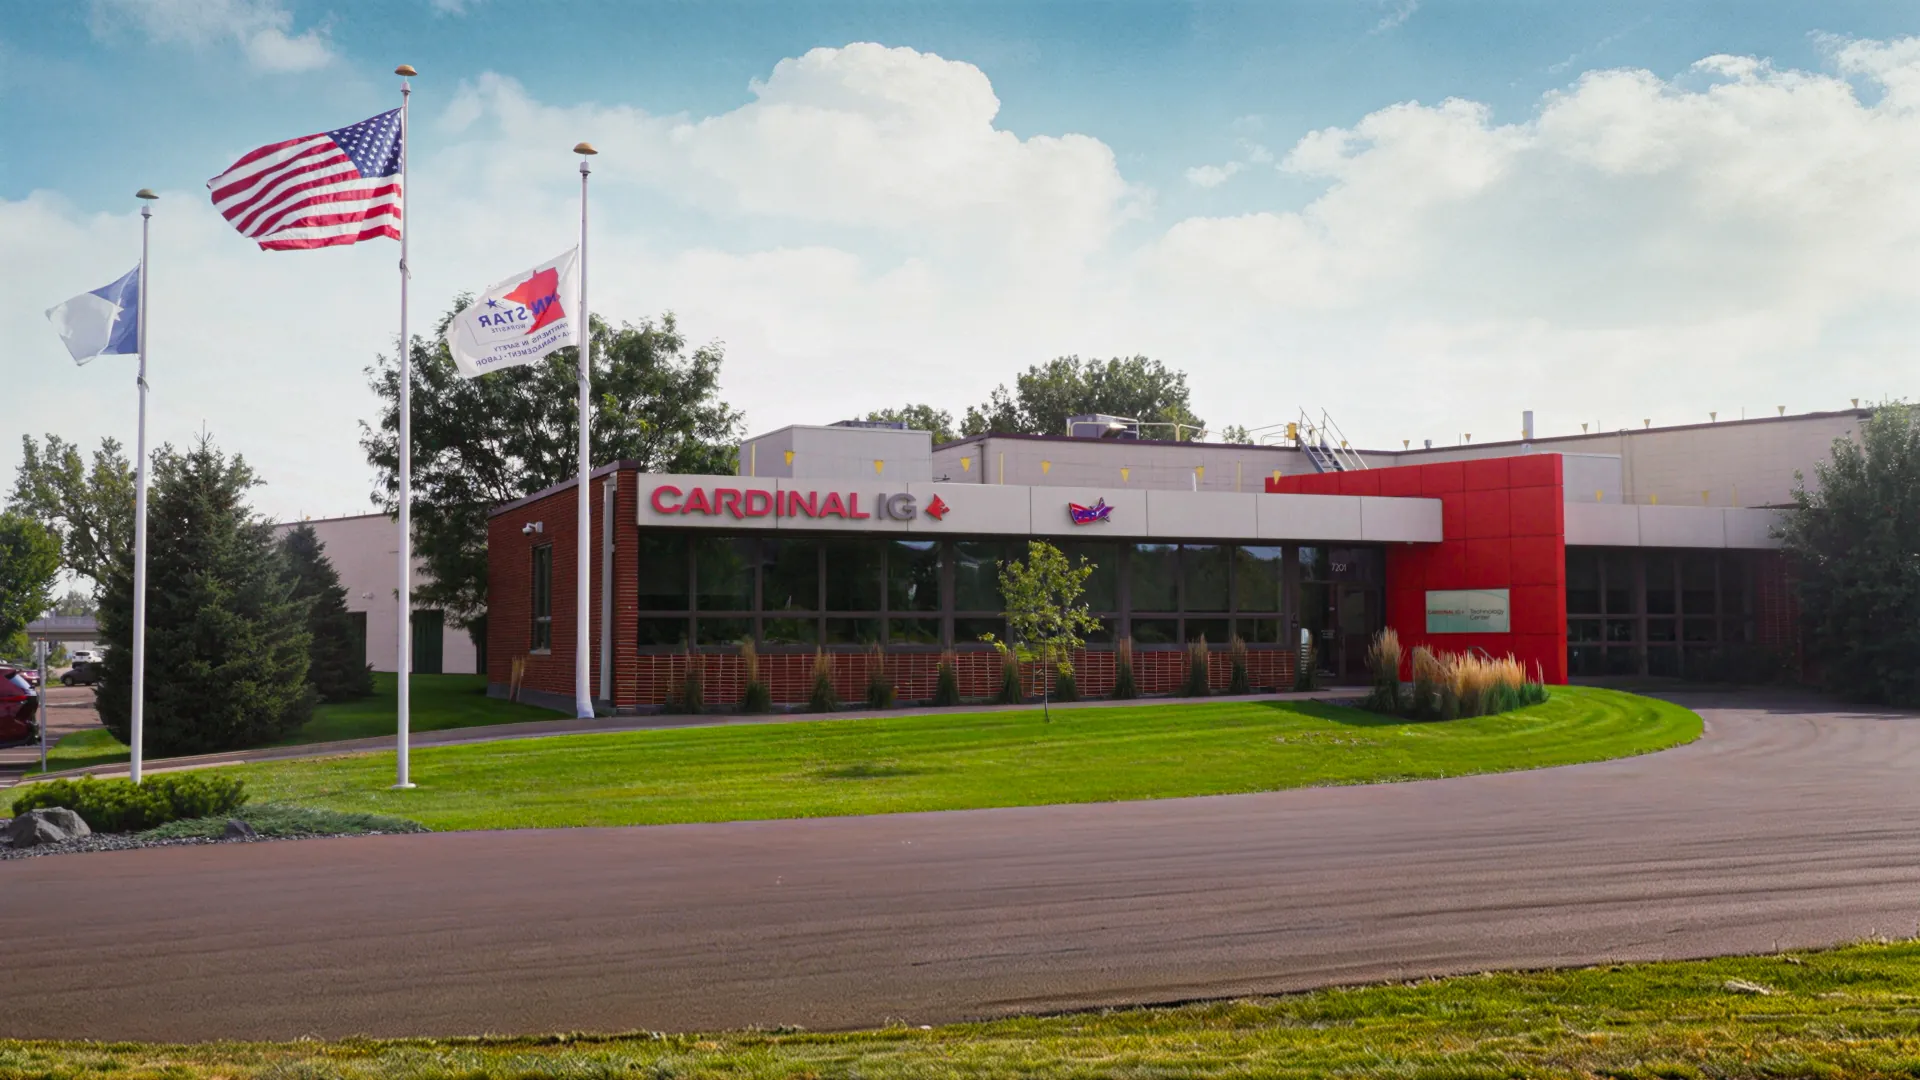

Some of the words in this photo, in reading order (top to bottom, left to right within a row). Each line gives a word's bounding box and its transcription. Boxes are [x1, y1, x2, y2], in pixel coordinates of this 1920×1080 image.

[651, 485, 870, 519] CARDINAL
[877, 492, 917, 520] IG
[1331, 563, 1347, 572] 7201
[1469, 608, 1504, 616] Technology
